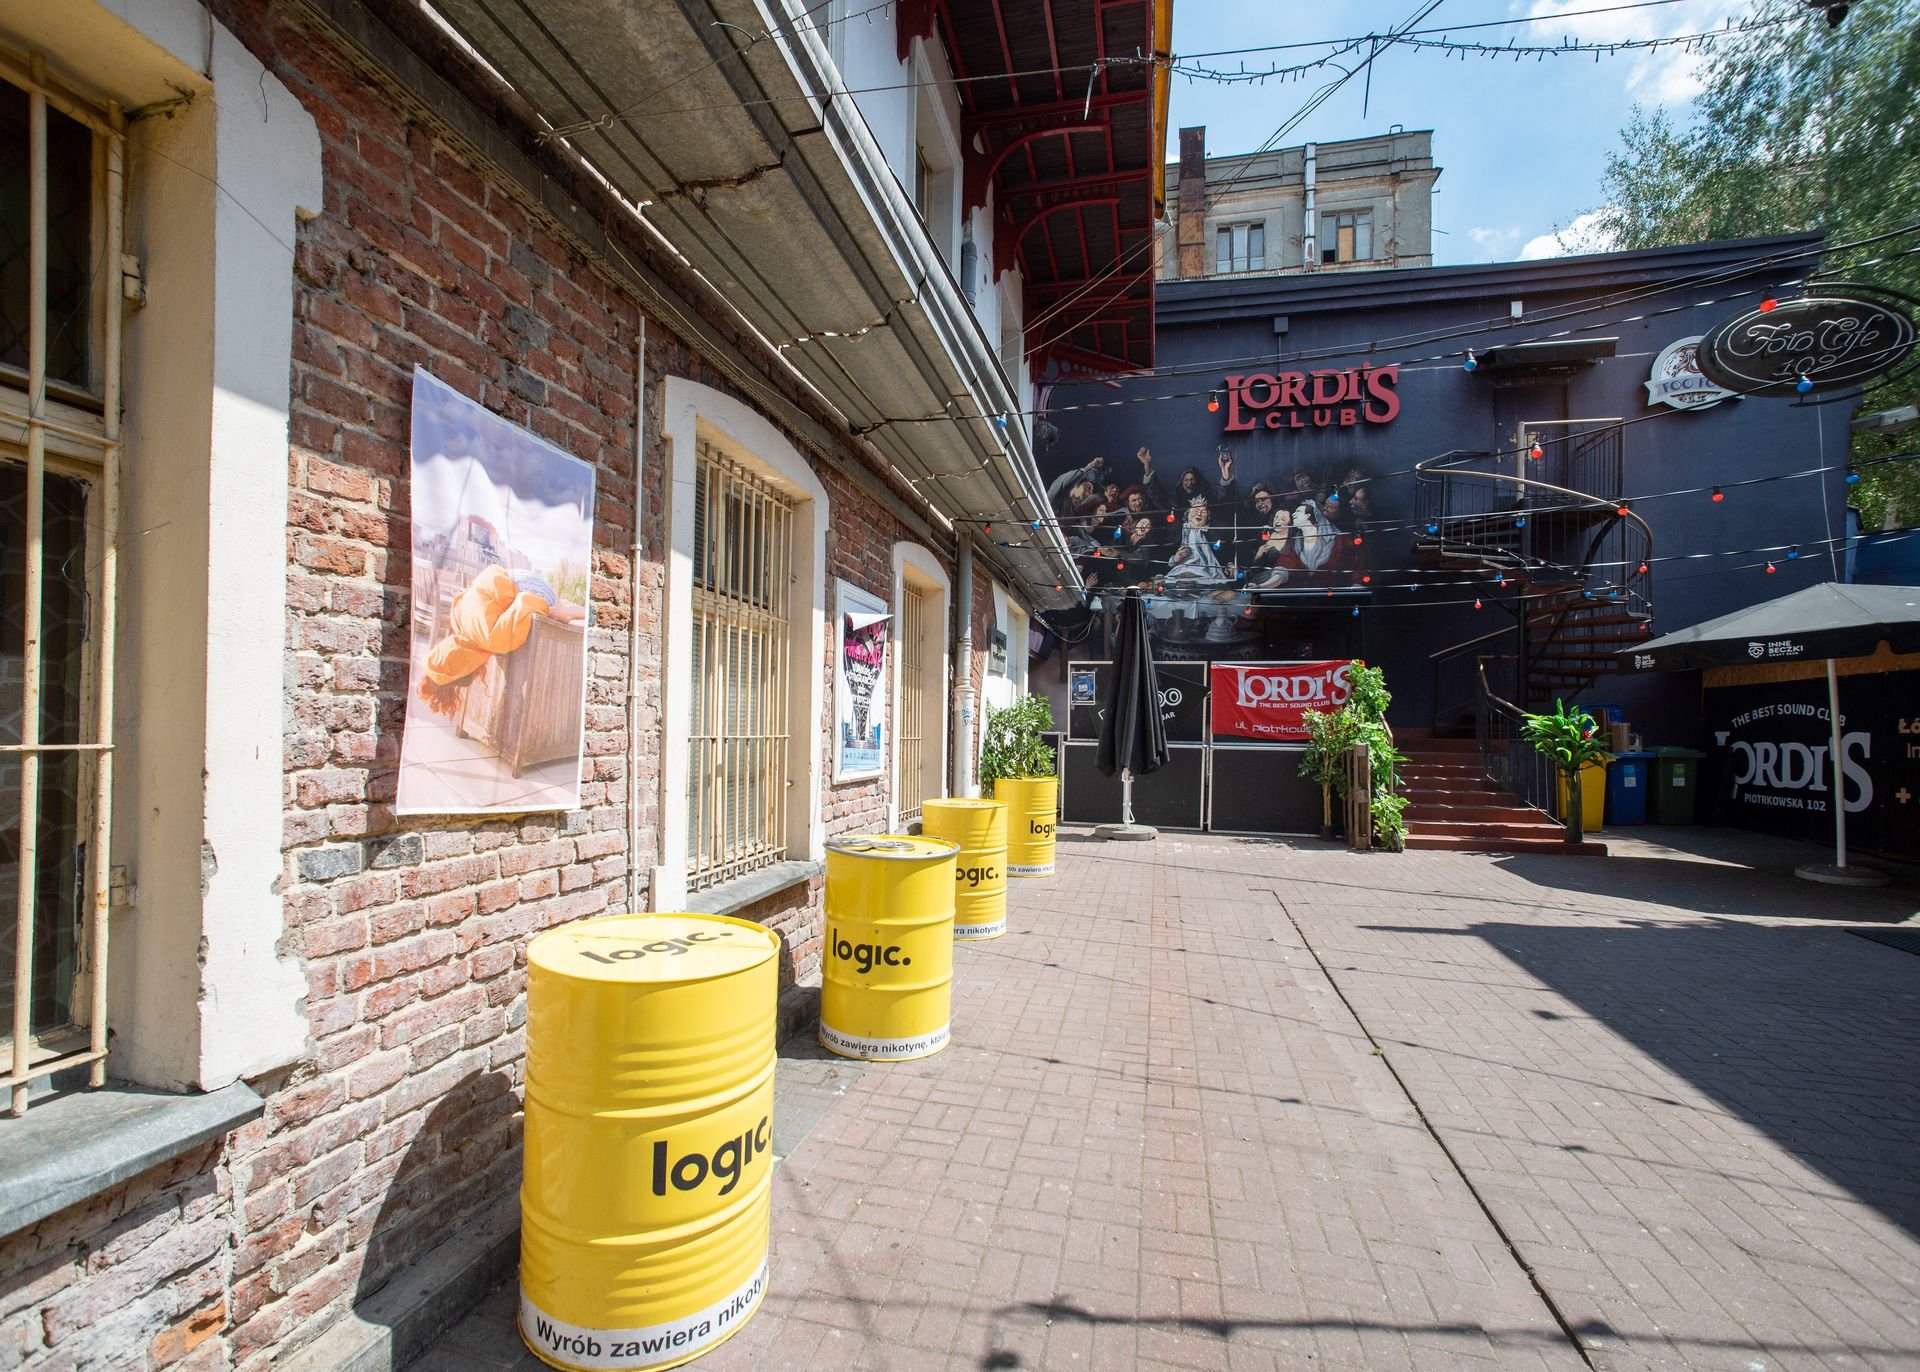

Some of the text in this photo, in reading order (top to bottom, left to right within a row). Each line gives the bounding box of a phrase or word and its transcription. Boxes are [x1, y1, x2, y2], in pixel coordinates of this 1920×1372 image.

[1224, 361, 1400, 432] LORDI'S
[1265, 408, 1358, 430] CLUB
[1768, 640, 1792, 648] INNE
[1768, 645, 1804, 654] BECZKI
[1236, 664, 1354, 709] LORDI'S
[1731, 703, 1847, 729] THE BEST SOUND CLB
[1715, 731, 1874, 813] ORDI'S
[1744, 793, 1827, 811] PIOTRKOWSKA 102
[956, 866, 999, 887] ogic.
[579, 932, 733, 965] logic.
[832, 927, 912, 974] logic.
[840, 1039, 878, 1053] zawiera
[881, 1041, 928, 1054] nikotynę,
[536, 1316, 602, 1358] Wyrób
[610, 1320, 711, 1358] zawiera
